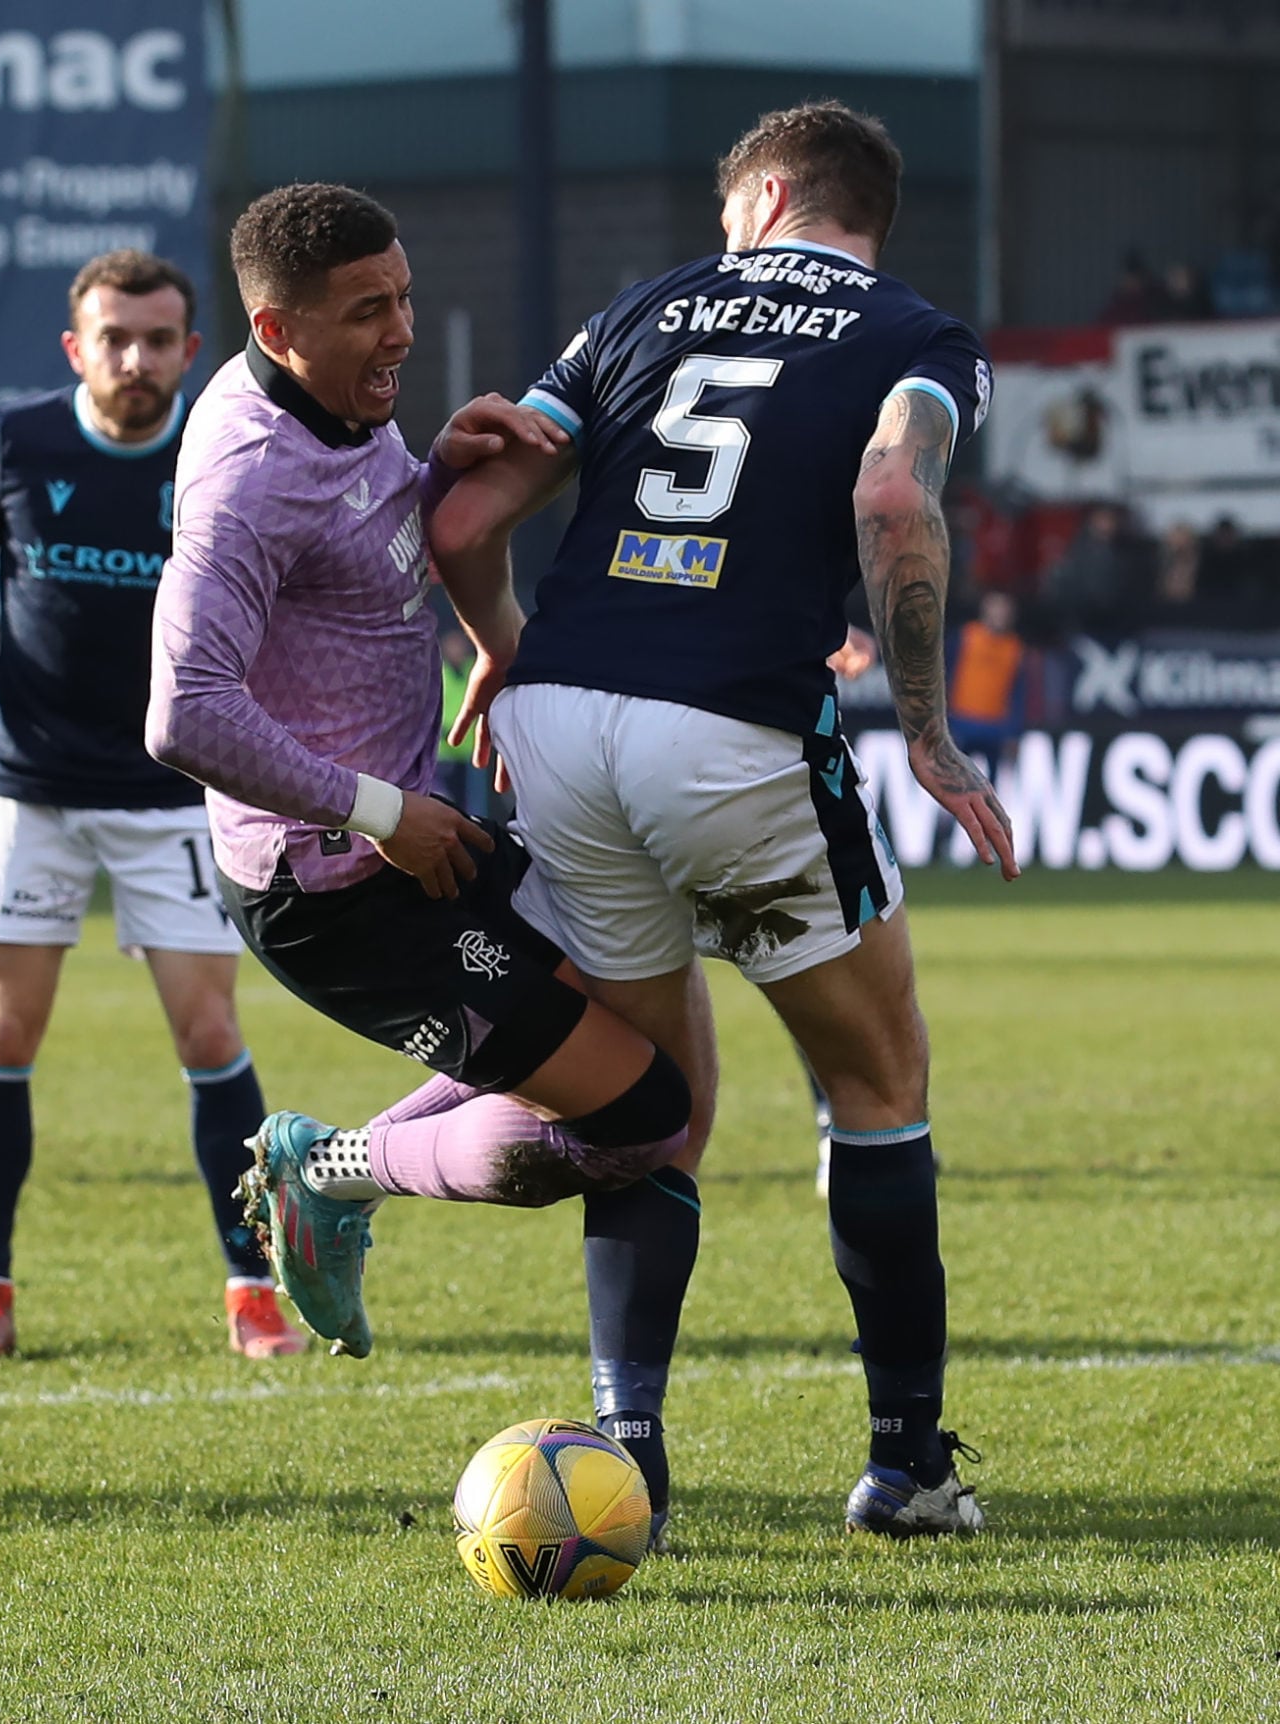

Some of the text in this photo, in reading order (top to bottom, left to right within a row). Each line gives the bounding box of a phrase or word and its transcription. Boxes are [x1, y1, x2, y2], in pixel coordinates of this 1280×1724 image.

[22, 158, 197, 216] Property
[658, 295, 861, 341] SWEENEY
[634, 354, 785, 522] 5
[617, 565, 709, 583] BUILDING SUPPLIES
[618, 534, 722, 574] MKM
[612, 1420, 651, 1440] 1893
